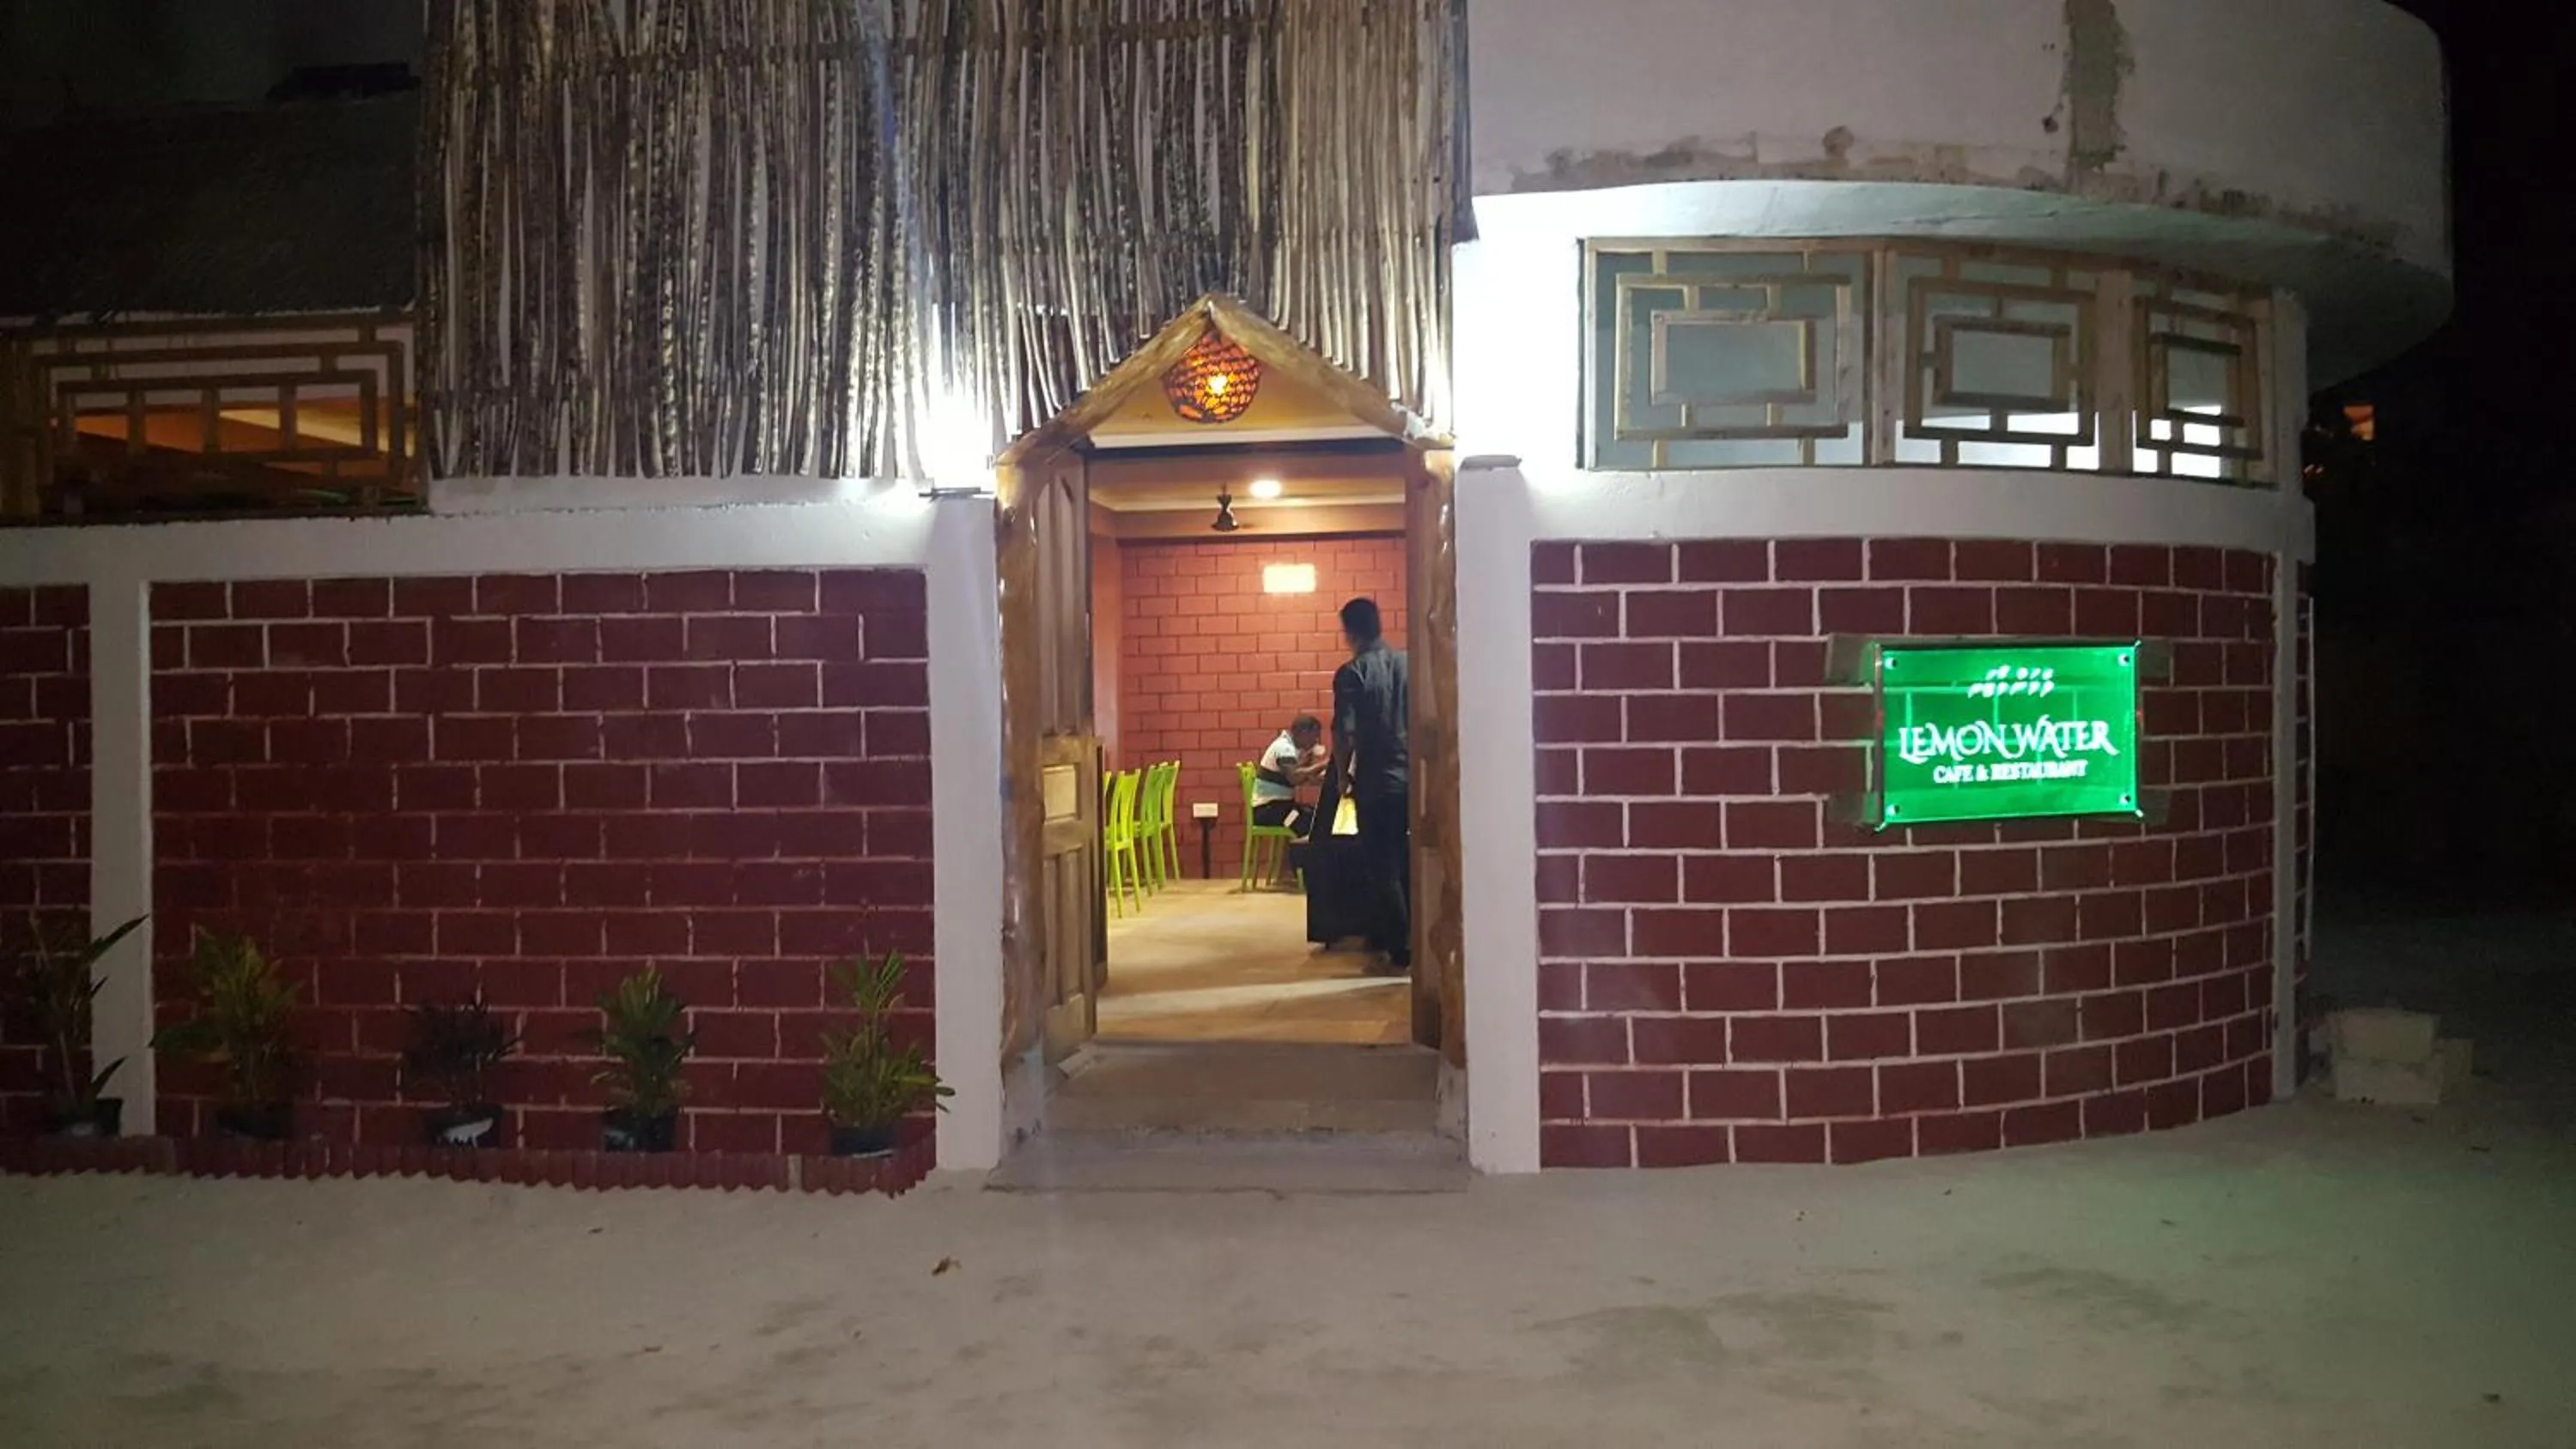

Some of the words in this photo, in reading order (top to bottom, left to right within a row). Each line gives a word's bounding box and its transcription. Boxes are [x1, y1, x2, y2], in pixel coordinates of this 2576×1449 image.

[1899, 719, 2007, 765] LEMON
[2012, 714, 2120, 759] WATER
[1933, 765, 1973, 783] CAFE
[1976, 763, 1989, 782] &
[1990, 759, 2087, 781] RESTAURANT
